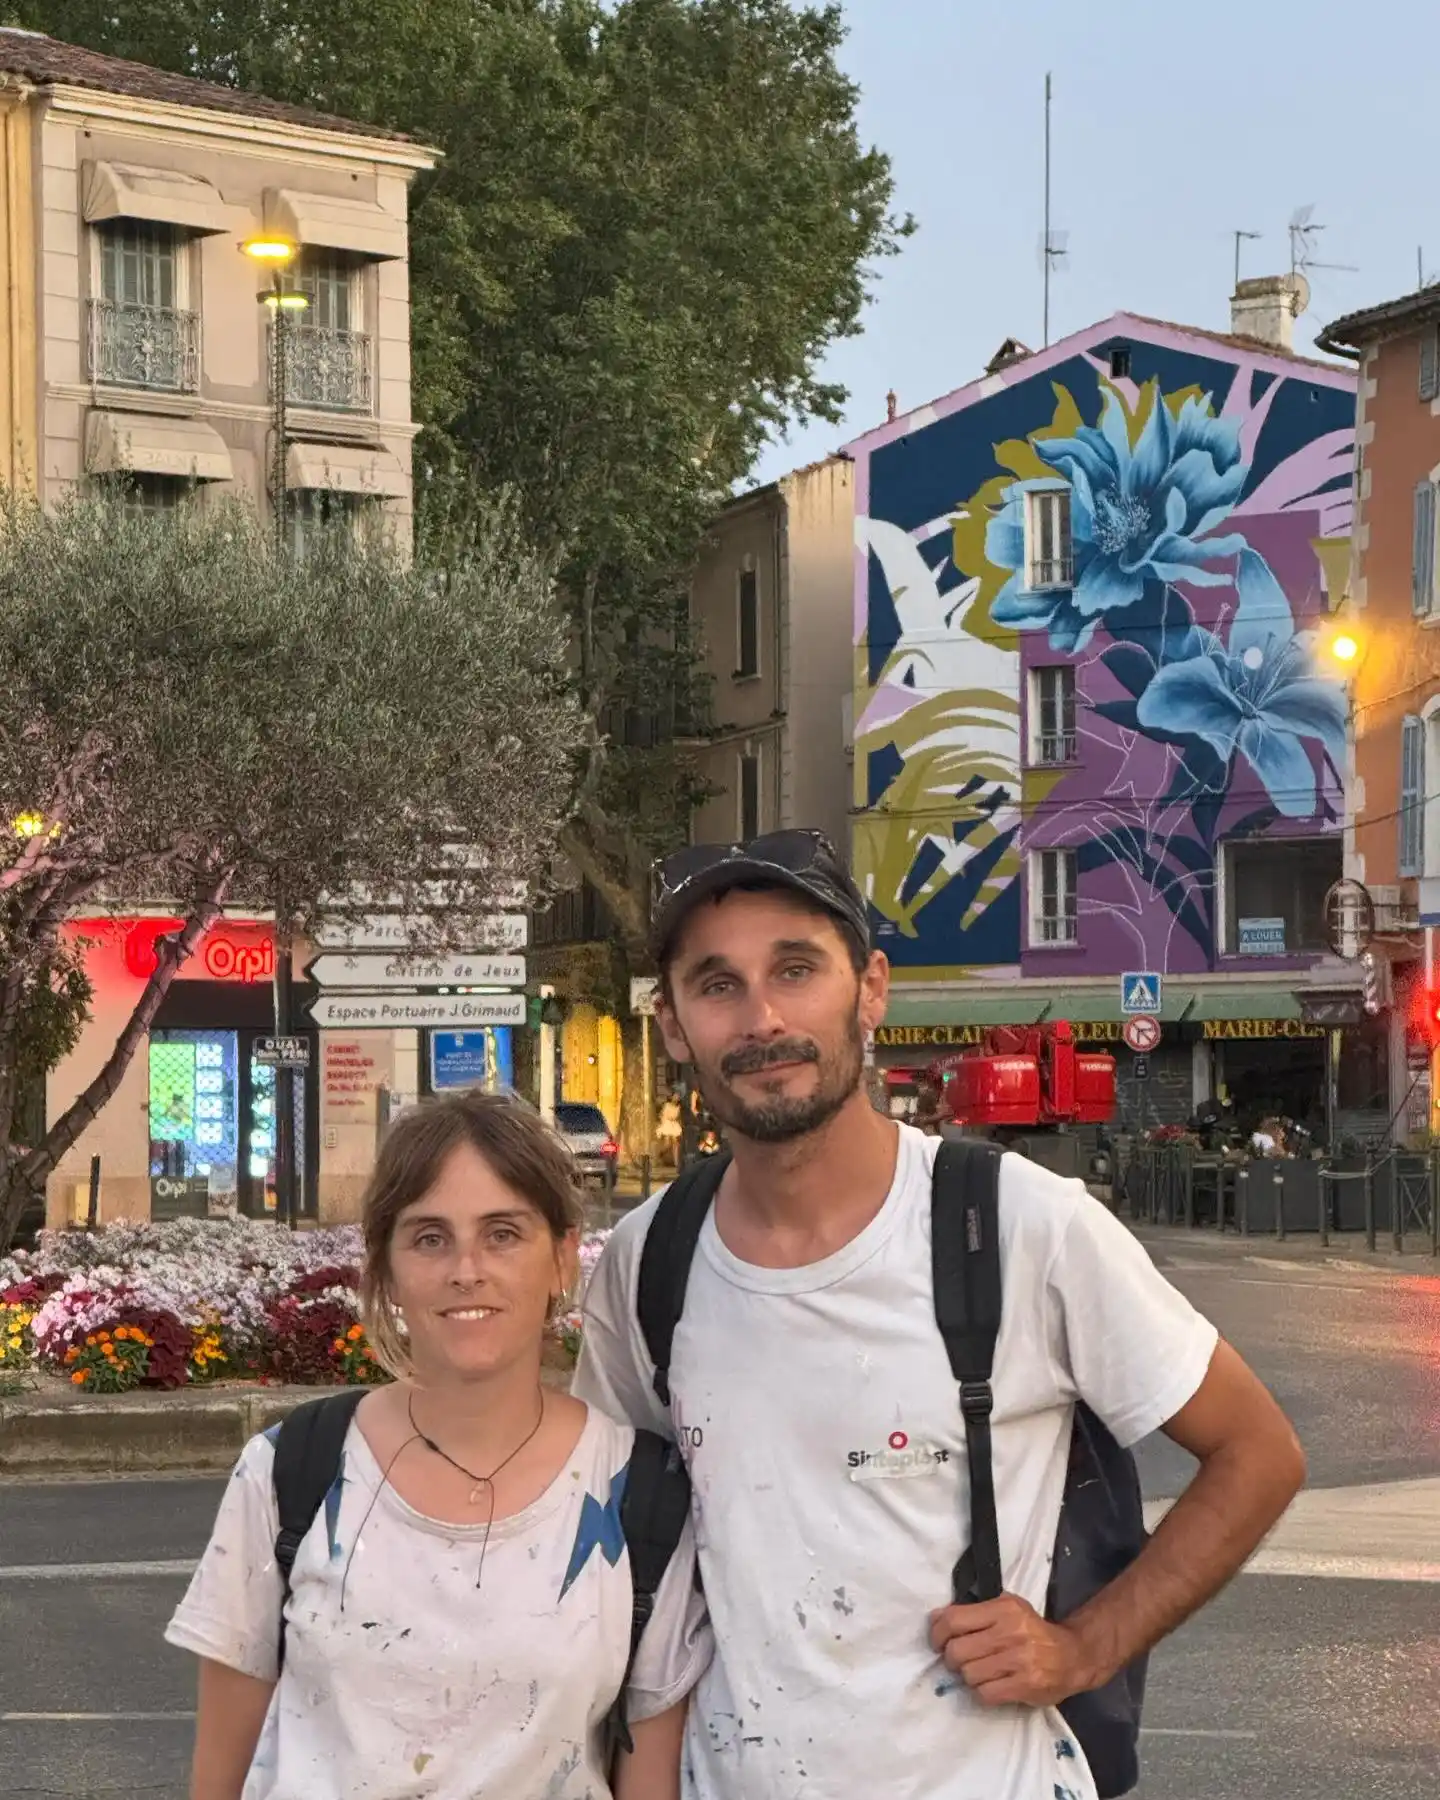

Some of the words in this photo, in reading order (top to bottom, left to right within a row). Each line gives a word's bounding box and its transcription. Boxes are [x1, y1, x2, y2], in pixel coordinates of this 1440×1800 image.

[1251, 930, 1283, 941] LOUER
[205, 938, 273, 983] Orpi
[454, 964, 472, 977] de
[482, 964, 520, 977] Jeux
[327, 1004, 376, 1021] Espace
[381, 1004, 446, 1018] Portuaire
